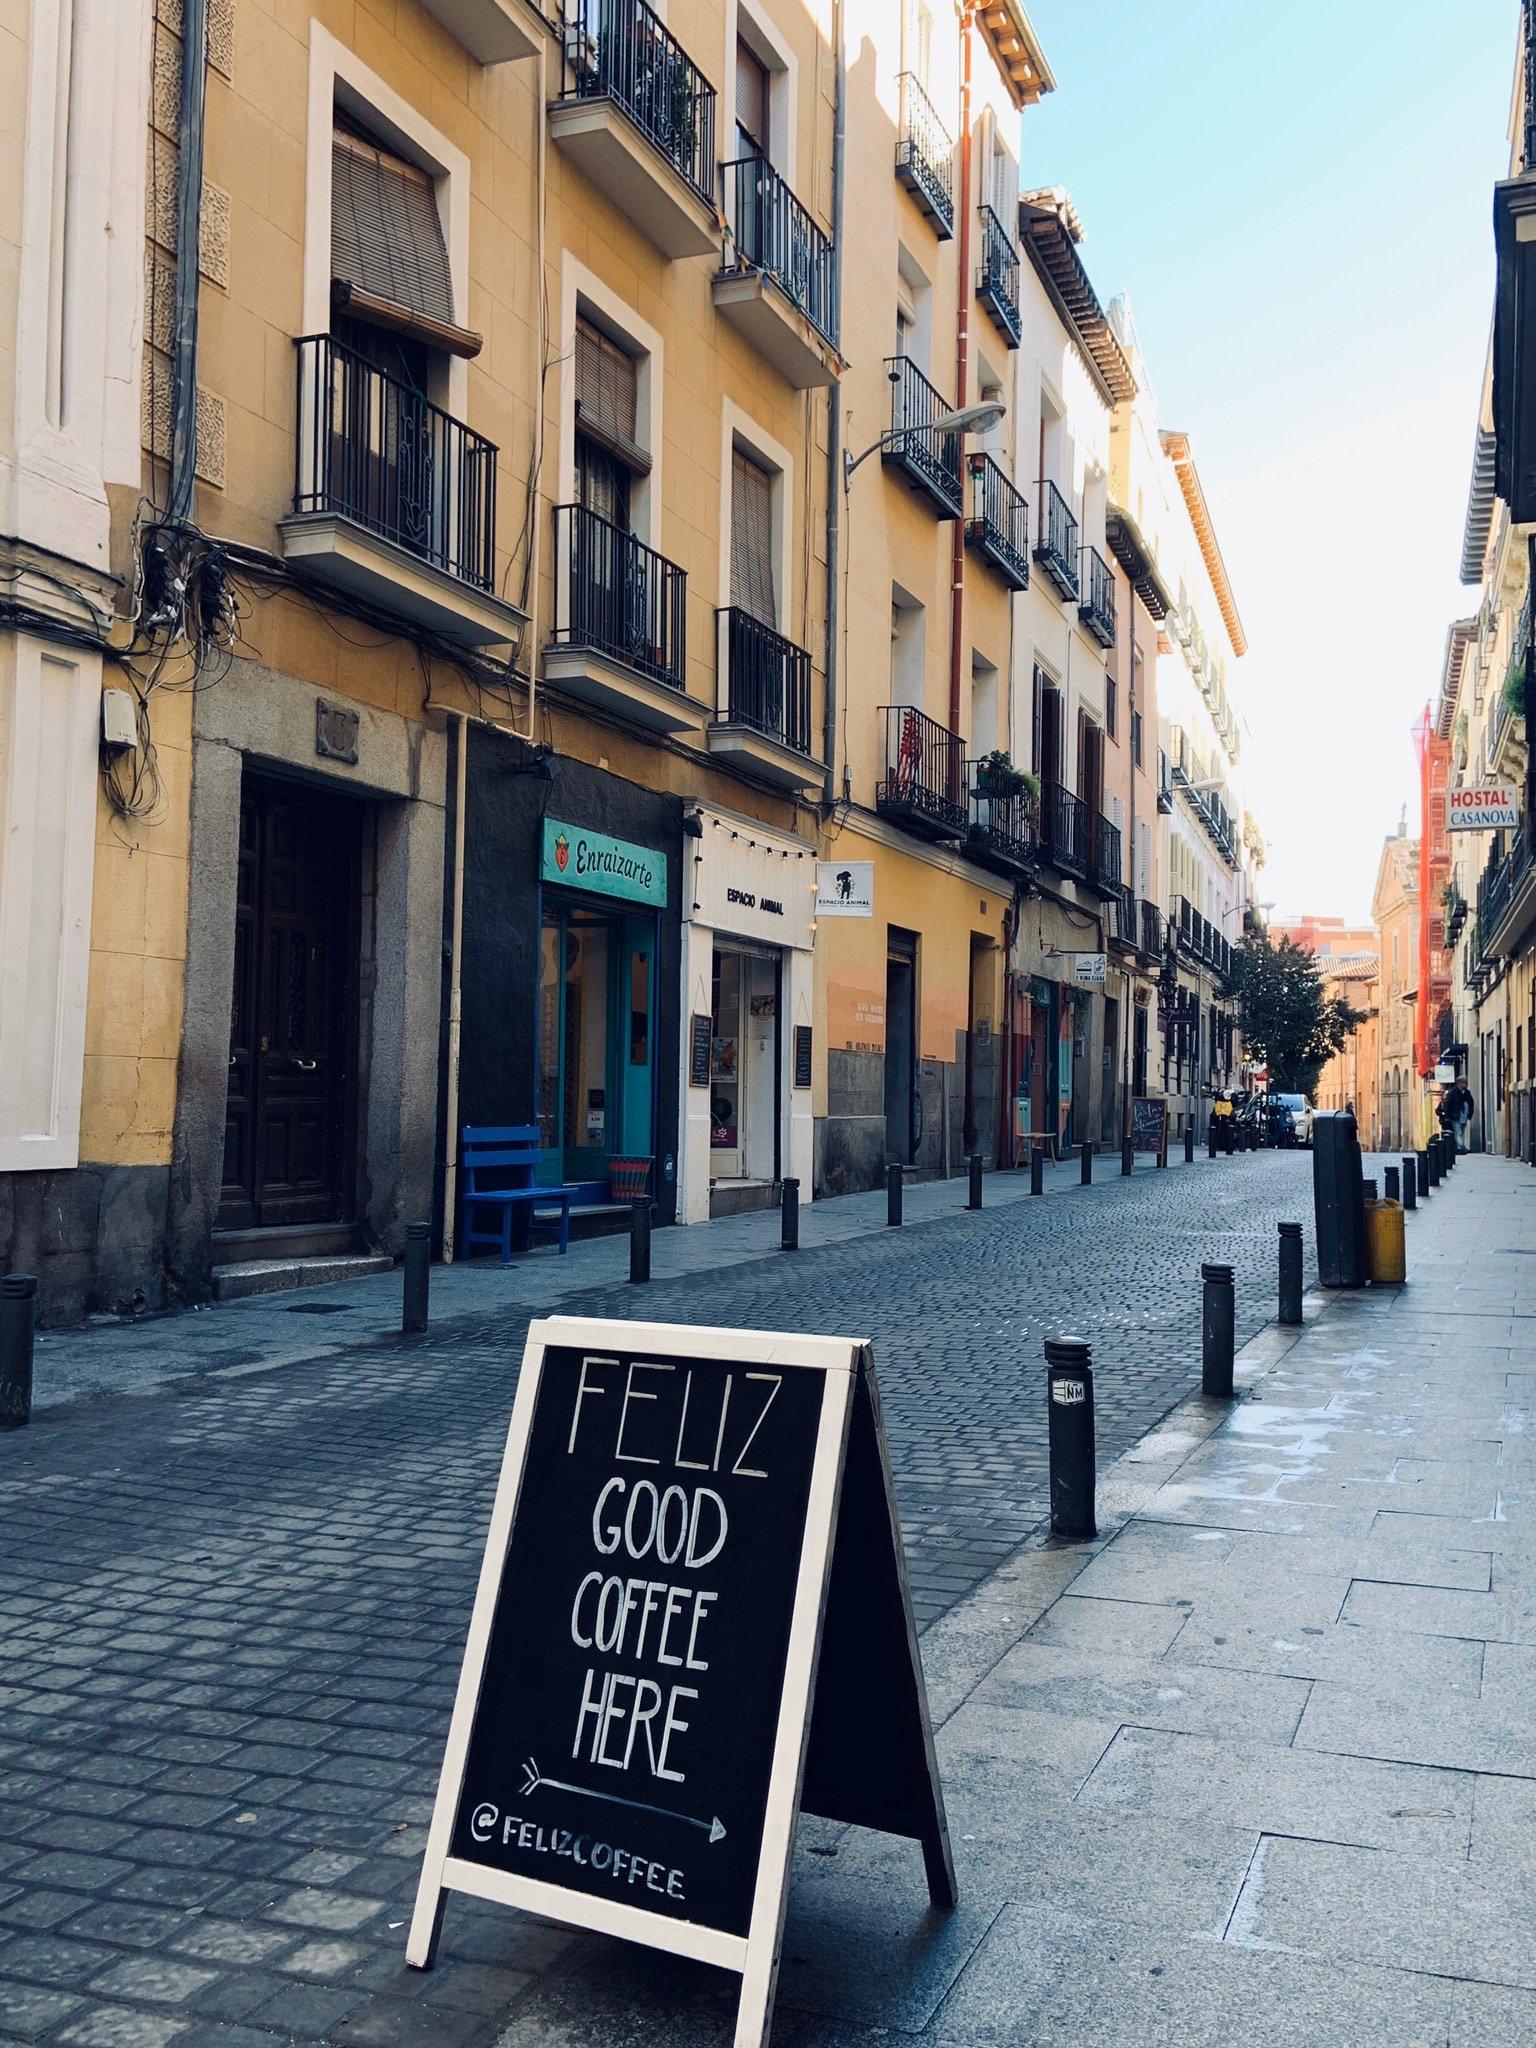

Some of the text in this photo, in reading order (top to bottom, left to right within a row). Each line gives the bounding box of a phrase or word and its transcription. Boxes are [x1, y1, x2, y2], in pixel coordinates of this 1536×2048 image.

[1450, 790, 1508, 807] HOSTAL
[1450, 810, 1515, 825] CASANOVA
[576, 839, 653, 889] Enraizarte
[727, 888, 785, 916] ESPACIO ANIMAL
[818, 898, 844, 906] ESPACIO
[567, 1356, 782, 1478] FELIZ
[592, 1476, 729, 1569] GOOD
[570, 1569, 719, 1672] COFFEE
[571, 1668, 700, 1783] HERE
[470, 1803, 686, 1900] @FELIZCOFFEE
